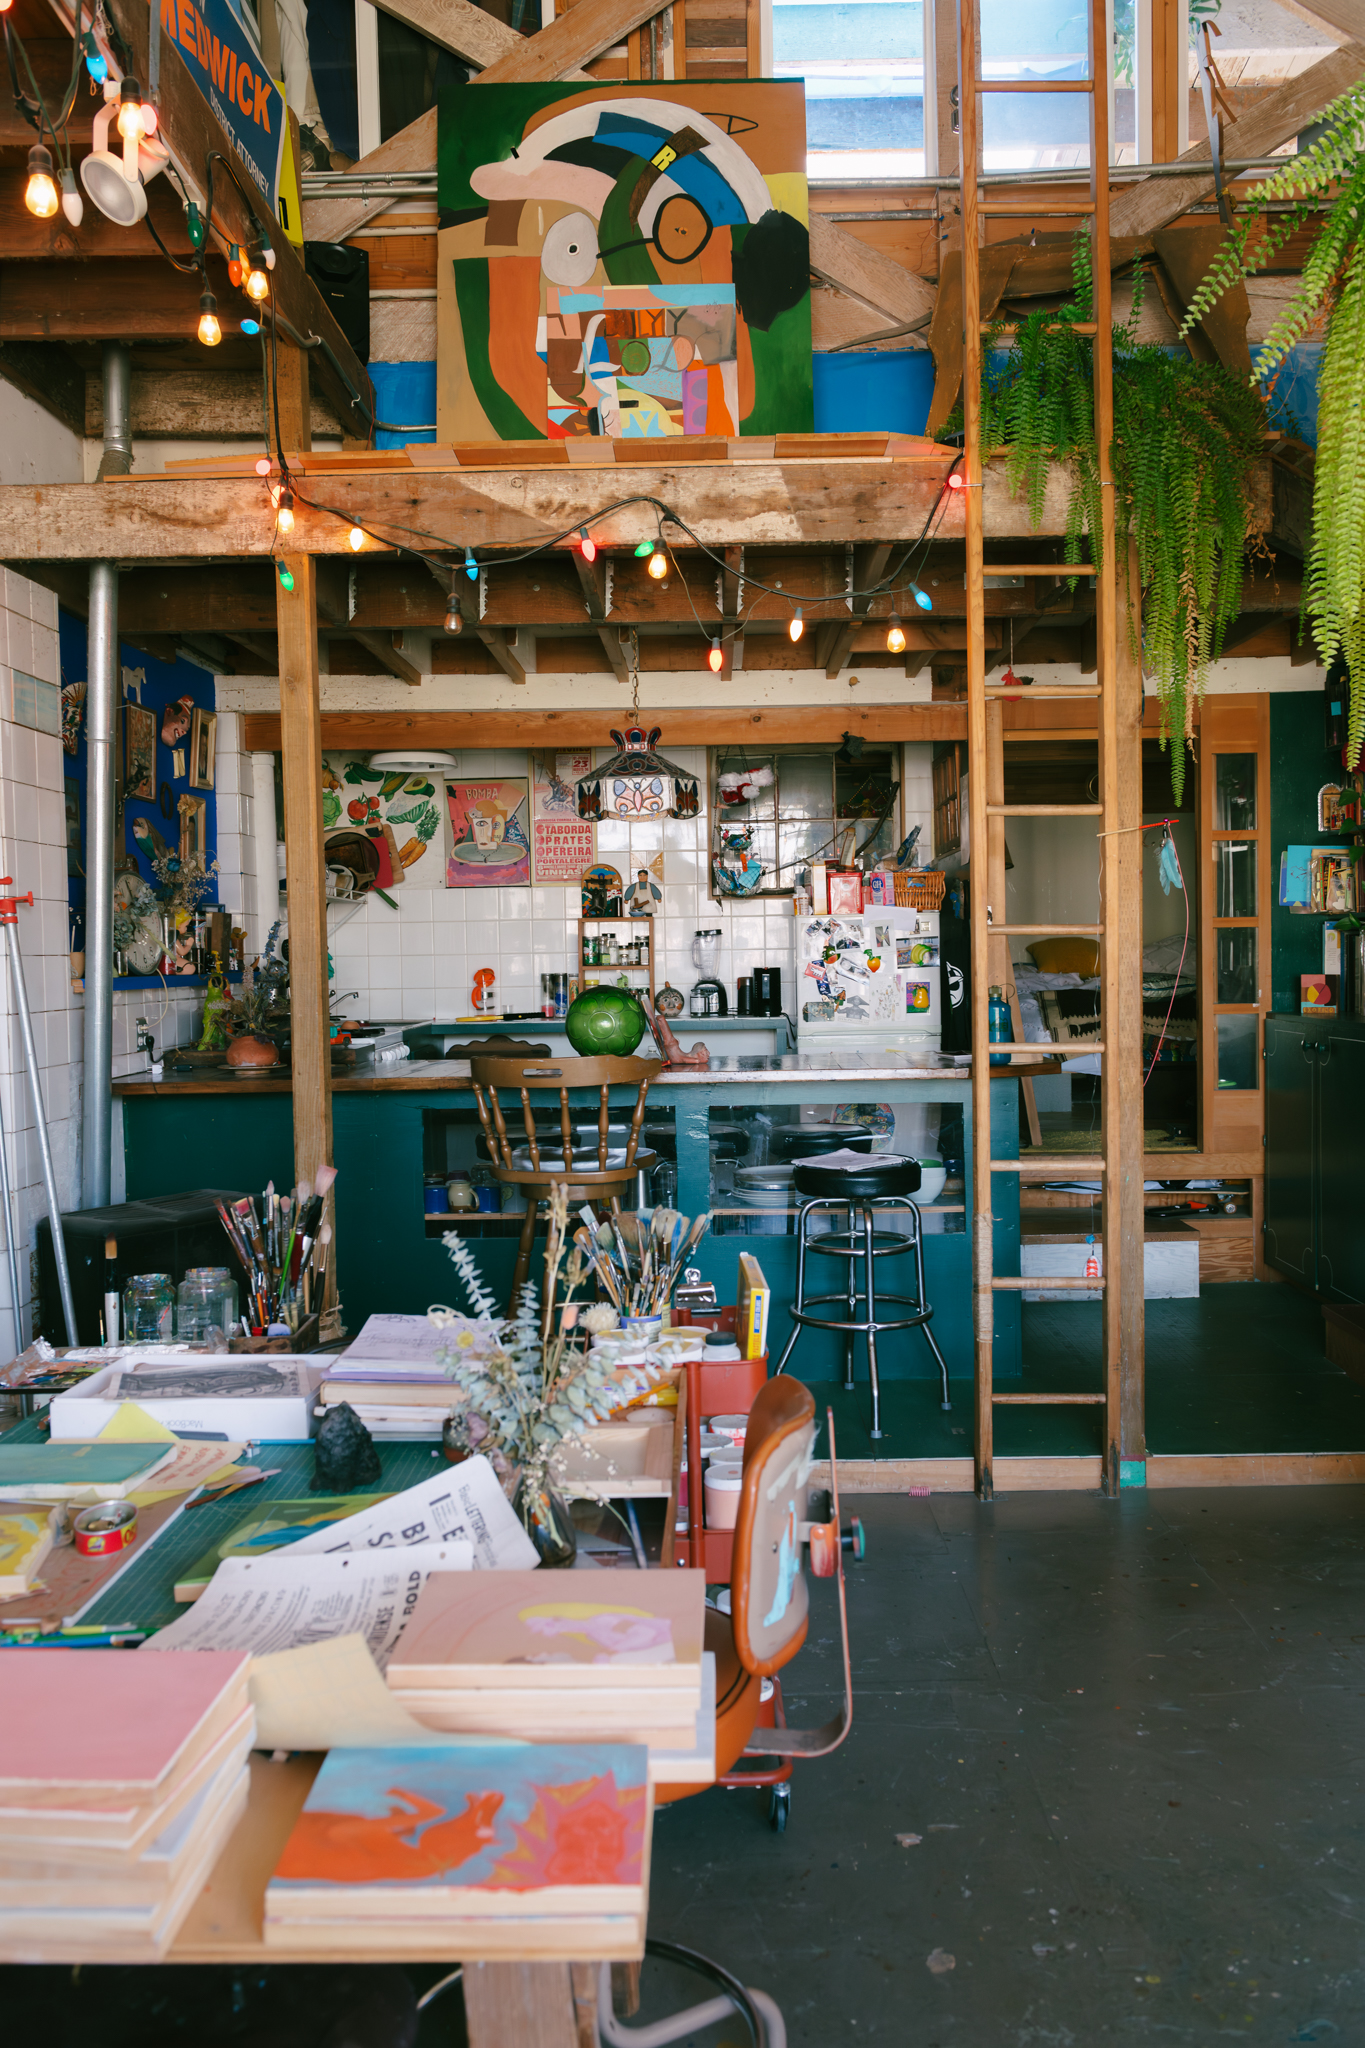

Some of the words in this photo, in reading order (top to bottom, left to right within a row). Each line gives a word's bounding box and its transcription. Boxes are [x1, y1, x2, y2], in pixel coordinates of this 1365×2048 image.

[210, 85, 235, 147] DISTRICT
[236, 138, 269, 197] ATTORNEY
[651, 145, 677, 172] R
[572, 760, 589, 768] 23
[465, 787, 499, 801] BOMBA
[545, 825, 592, 835] TABORDA
[545, 836, 592, 845] PRATES
[545, 847, 592, 856] PEREIRA
[538, 868, 582, 876] VINHAS
[166, 1420, 204, 1430] MacBook
